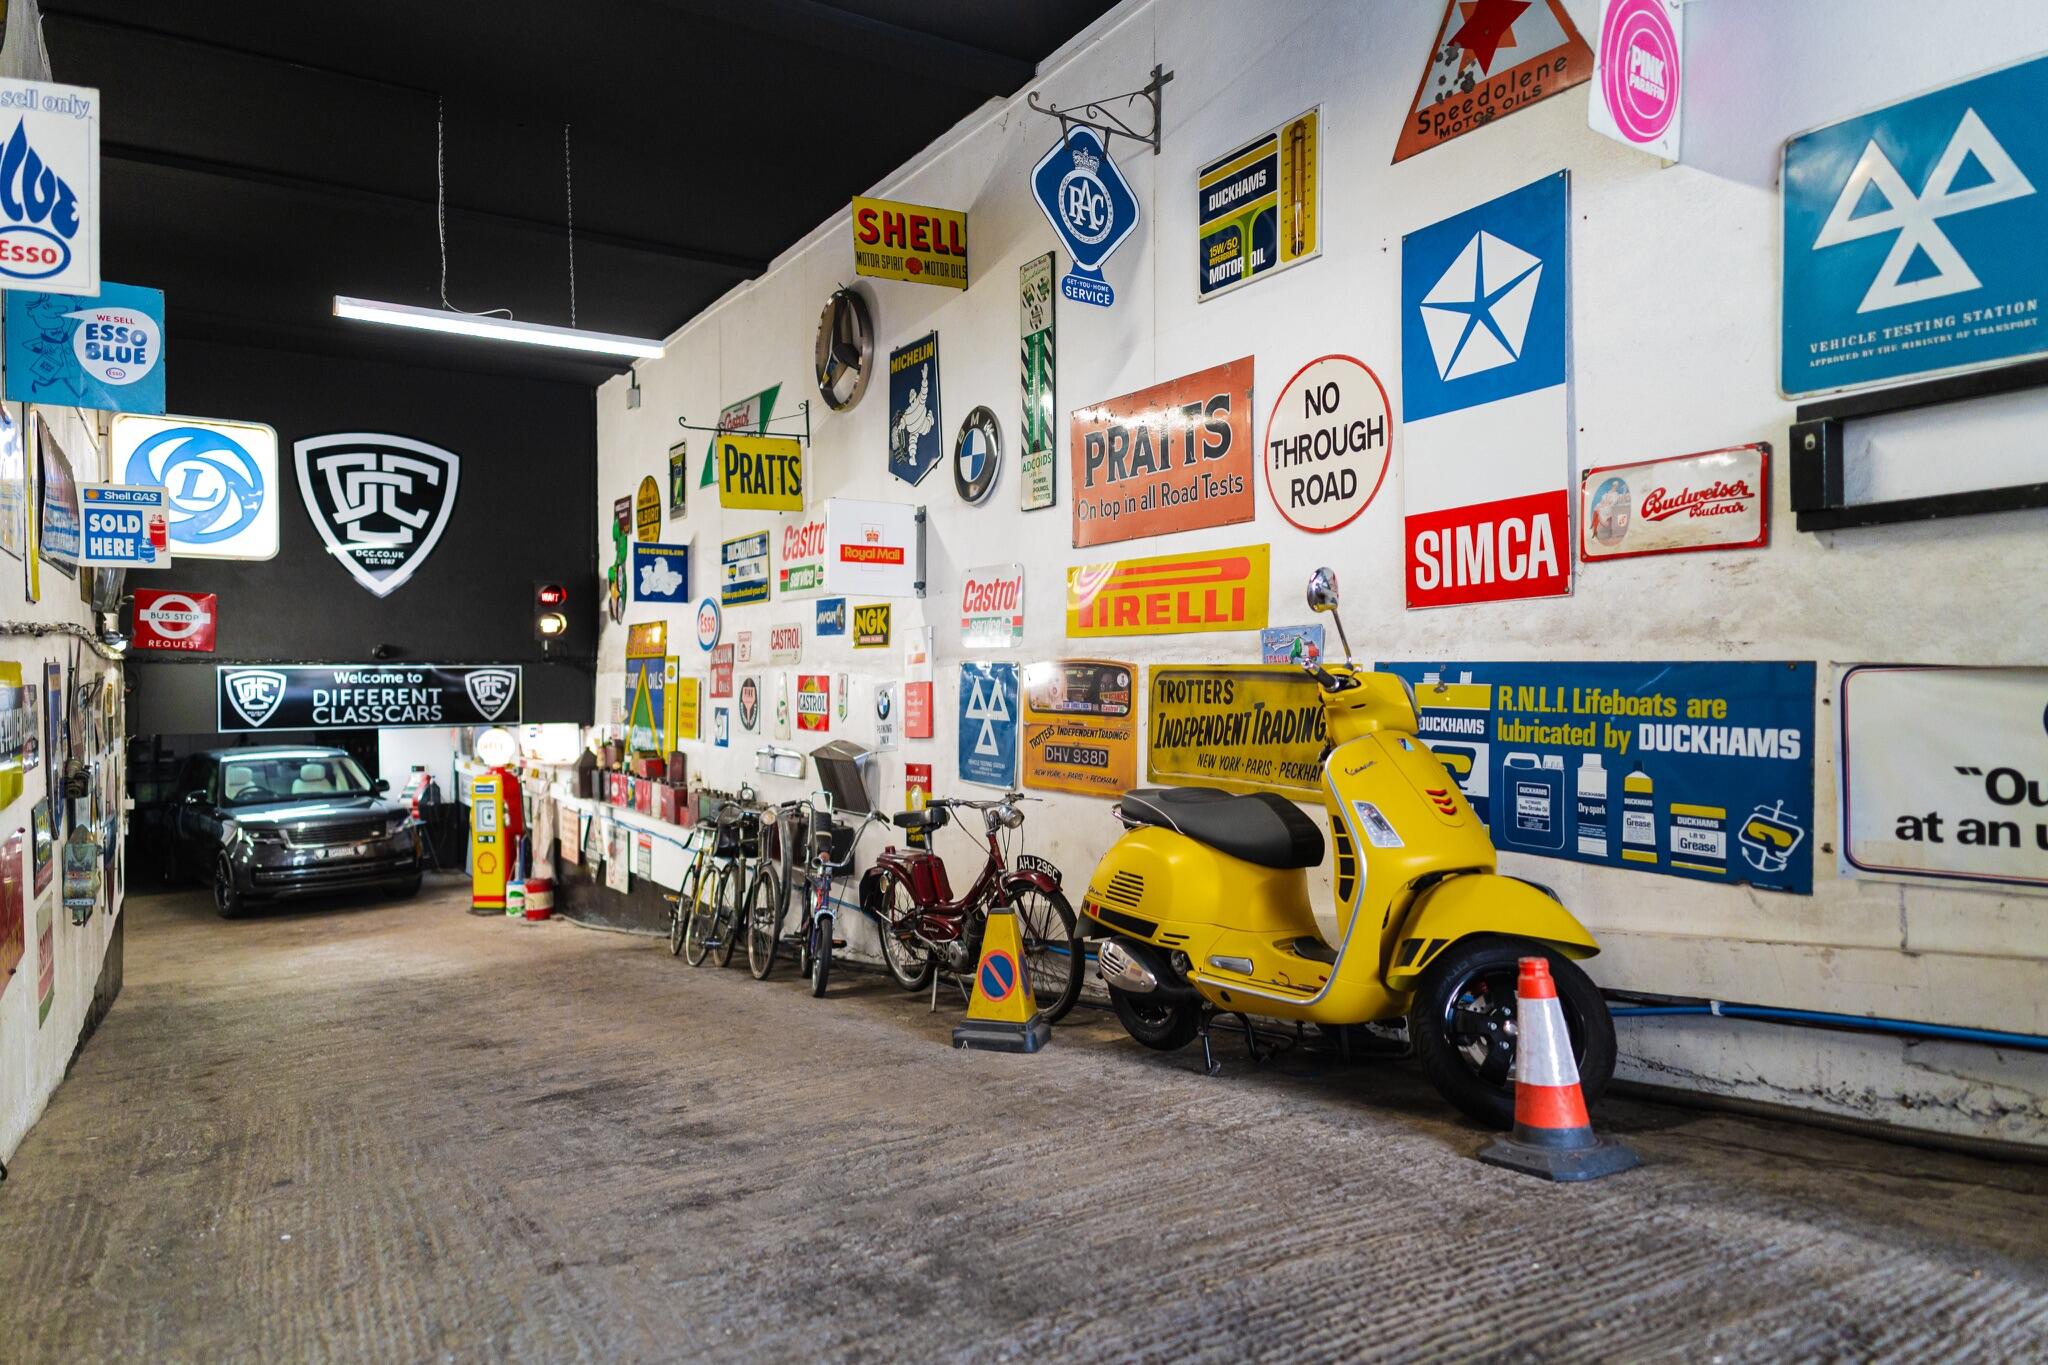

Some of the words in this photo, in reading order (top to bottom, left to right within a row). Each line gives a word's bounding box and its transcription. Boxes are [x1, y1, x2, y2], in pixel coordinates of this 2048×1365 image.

[1630, 45, 1665, 84] PINK
[1418, 56, 1568, 137] Speedolene
[1630, 75, 1665, 101] PARAFFIN
[1, 88, 38, 109] sell
[42, 94, 90, 119] only
[1439, 106, 1496, 139] MOTOR
[1502, 85, 1543, 110] OILS
[1209, 169, 1267, 212] DUCKHAMS
[1069, 179, 1104, 230] RAC
[857, 208, 966, 257] SHELL
[1210, 236, 1239, 257] 15W/50
[856, 251, 880, 268] MOTOR
[881, 254, 903, 271] SPIRIT
[924, 260, 949, 278] MOTOR
[951, 264, 967, 280] OILS
[1209, 256, 1245, 285] MOTOR
[1250, 248, 1266, 268] OIL
[1065, 286, 1110, 305] SERVICE
[96, 314, 112, 322] WE
[114, 316, 135, 325] SELL
[1810, 332, 1877, 354] VEHICLE
[1882, 315, 1956, 339] TESTING
[1963, 299, 2038, 324] STATION
[86, 323, 148, 347] ESSO
[1809, 351, 1859, 367] APPROVED
[1862, 349, 1874, 358] BY
[1877, 345, 1897, 355] THE
[1901, 334, 1953, 350] MINISTRY
[1956, 331, 1970, 339] OF
[1973, 318, 2038, 337] TRANSPORT
[85, 341, 147, 364] BLUE
[890, 341, 934, 374] MICHELIN
[1304, 381, 1340, 419] NO
[1084, 393, 1232, 488] PRATTS
[1270, 415, 1384, 470] THROUGH
[724, 444, 801, 497] PRATTS
[1022, 453, 1052, 473] ADCOIDS
[104, 490, 131, 501] Shell
[133, 492, 157, 502] GAS
[176, 468, 218, 502] L
[1078, 500, 1096, 521] On
[1100, 499, 1120, 520] top
[1124, 493, 1136, 513] in
[1140, 488, 1156, 511] all
[1161, 477, 1198, 507] Road
[1201, 473, 1244, 499] Tests
[1291, 468, 1357, 508] ROAD
[1640, 479, 1756, 522] Budweiser
[1689, 502, 1749, 518] Budvar
[89, 514, 140, 533] SOLD
[91, 537, 135, 556] HERE
[638, 547, 685, 556] MICHELIN
[727, 537, 760, 561] DUCKHAMS
[782, 521, 824, 561] Castro
[1415, 513, 1559, 591] SIMCA
[355, 549, 404, 558] DCC.CO.UK
[844, 546, 876, 561] Royal
[877, 548, 900, 561] Mail
[541, 592, 559, 602] WAIT
[963, 576, 1021, 613] Castrol
[1078, 557, 1250, 627] PIRELLI
[151, 611, 170, 620] BUS
[174, 612, 199, 621] STOP
[817, 611, 837, 625] AVON
[855, 607, 887, 634] NGK
[149, 639, 201, 649] REQUEST
[771, 628, 799, 650] CASTROL
[1265, 655, 1289, 664] ITALIA
[334, 671, 403, 684] Welcome
[407, 672, 423, 683] to
[648, 673, 663, 689] OILS
[313, 688, 442, 707] DIFFERENT
[799, 694, 826, 712] CASTROL
[1158, 679, 1234, 705] TROTTERS
[1498, 685, 1568, 714] R.N.L.I.
[1573, 687, 1677, 717] Lifeboats
[1687, 697, 1727, 720] are
[312, 705, 442, 723] CLASSCARS
[1154, 712, 1252, 749] INDEPENDENT
[1252, 702, 1326, 746] TRADING
[1419, 717, 1484, 735] DUCKHAMS
[1029, 725, 1055, 750] TROTTERS
[1057, 726, 1098, 739] INDEPENDENT
[1098, 728, 1123, 741] TRADING
[1498, 717, 1596, 746] lubricated
[1604, 721, 1631, 755] by
[1638, 723, 1801, 760] DUCKHAMS
[1046, 746, 1070, 762] DHV
[1073, 749, 1107, 766] 938D
[1197, 754, 1217, 769] NEW
[1219, 756, 1241, 772] YORK
[1245, 758, 1273, 777] PARIS
[906, 775, 928, 783] DUNLOP
[1034, 768, 1046, 776] NEW
[1046, 769, 1061, 778] YORK
[1067, 771, 1084, 780] PARIS
[1090, 774, 1118, 785] PECKHAM
[1519, 786, 1548, 796] DUCKHAMS
[1624, 798, 1653, 807] DUCKHAMS
[1626, 817, 1651, 828] Grease
[1677, 816, 1719, 829] DUCKHAMS
[1895, 811, 1944, 843] at
[1956, 818, 2021, 848] an
[1680, 837, 1716, 853] Grease
[1019, 856, 1035, 870] AHJ
[1036, 859, 1059, 881] 296C
